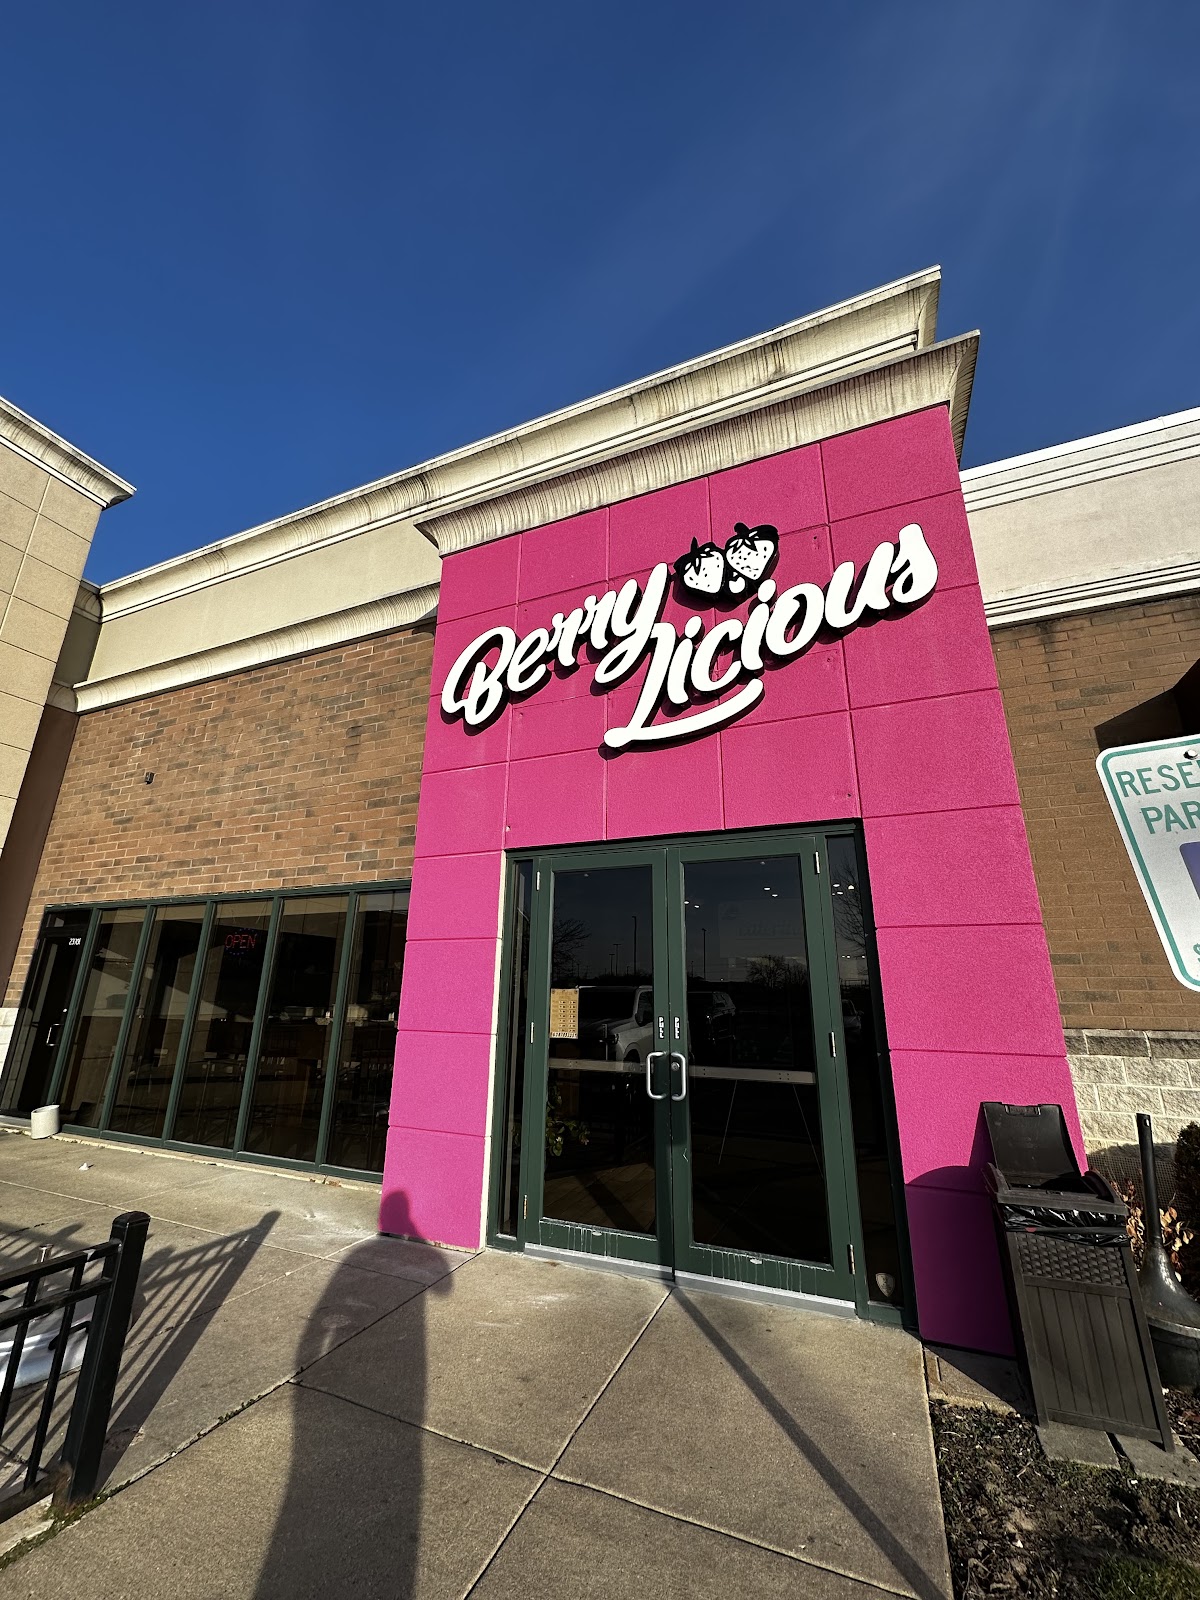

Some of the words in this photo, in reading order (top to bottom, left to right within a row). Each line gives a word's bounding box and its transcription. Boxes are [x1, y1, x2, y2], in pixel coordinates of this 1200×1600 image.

[441, 562, 669, 727] Berry
[603, 522, 939, 748] Licious
[1115, 759, 1200, 798] RESE
[224, 933, 257, 949] OPEN
